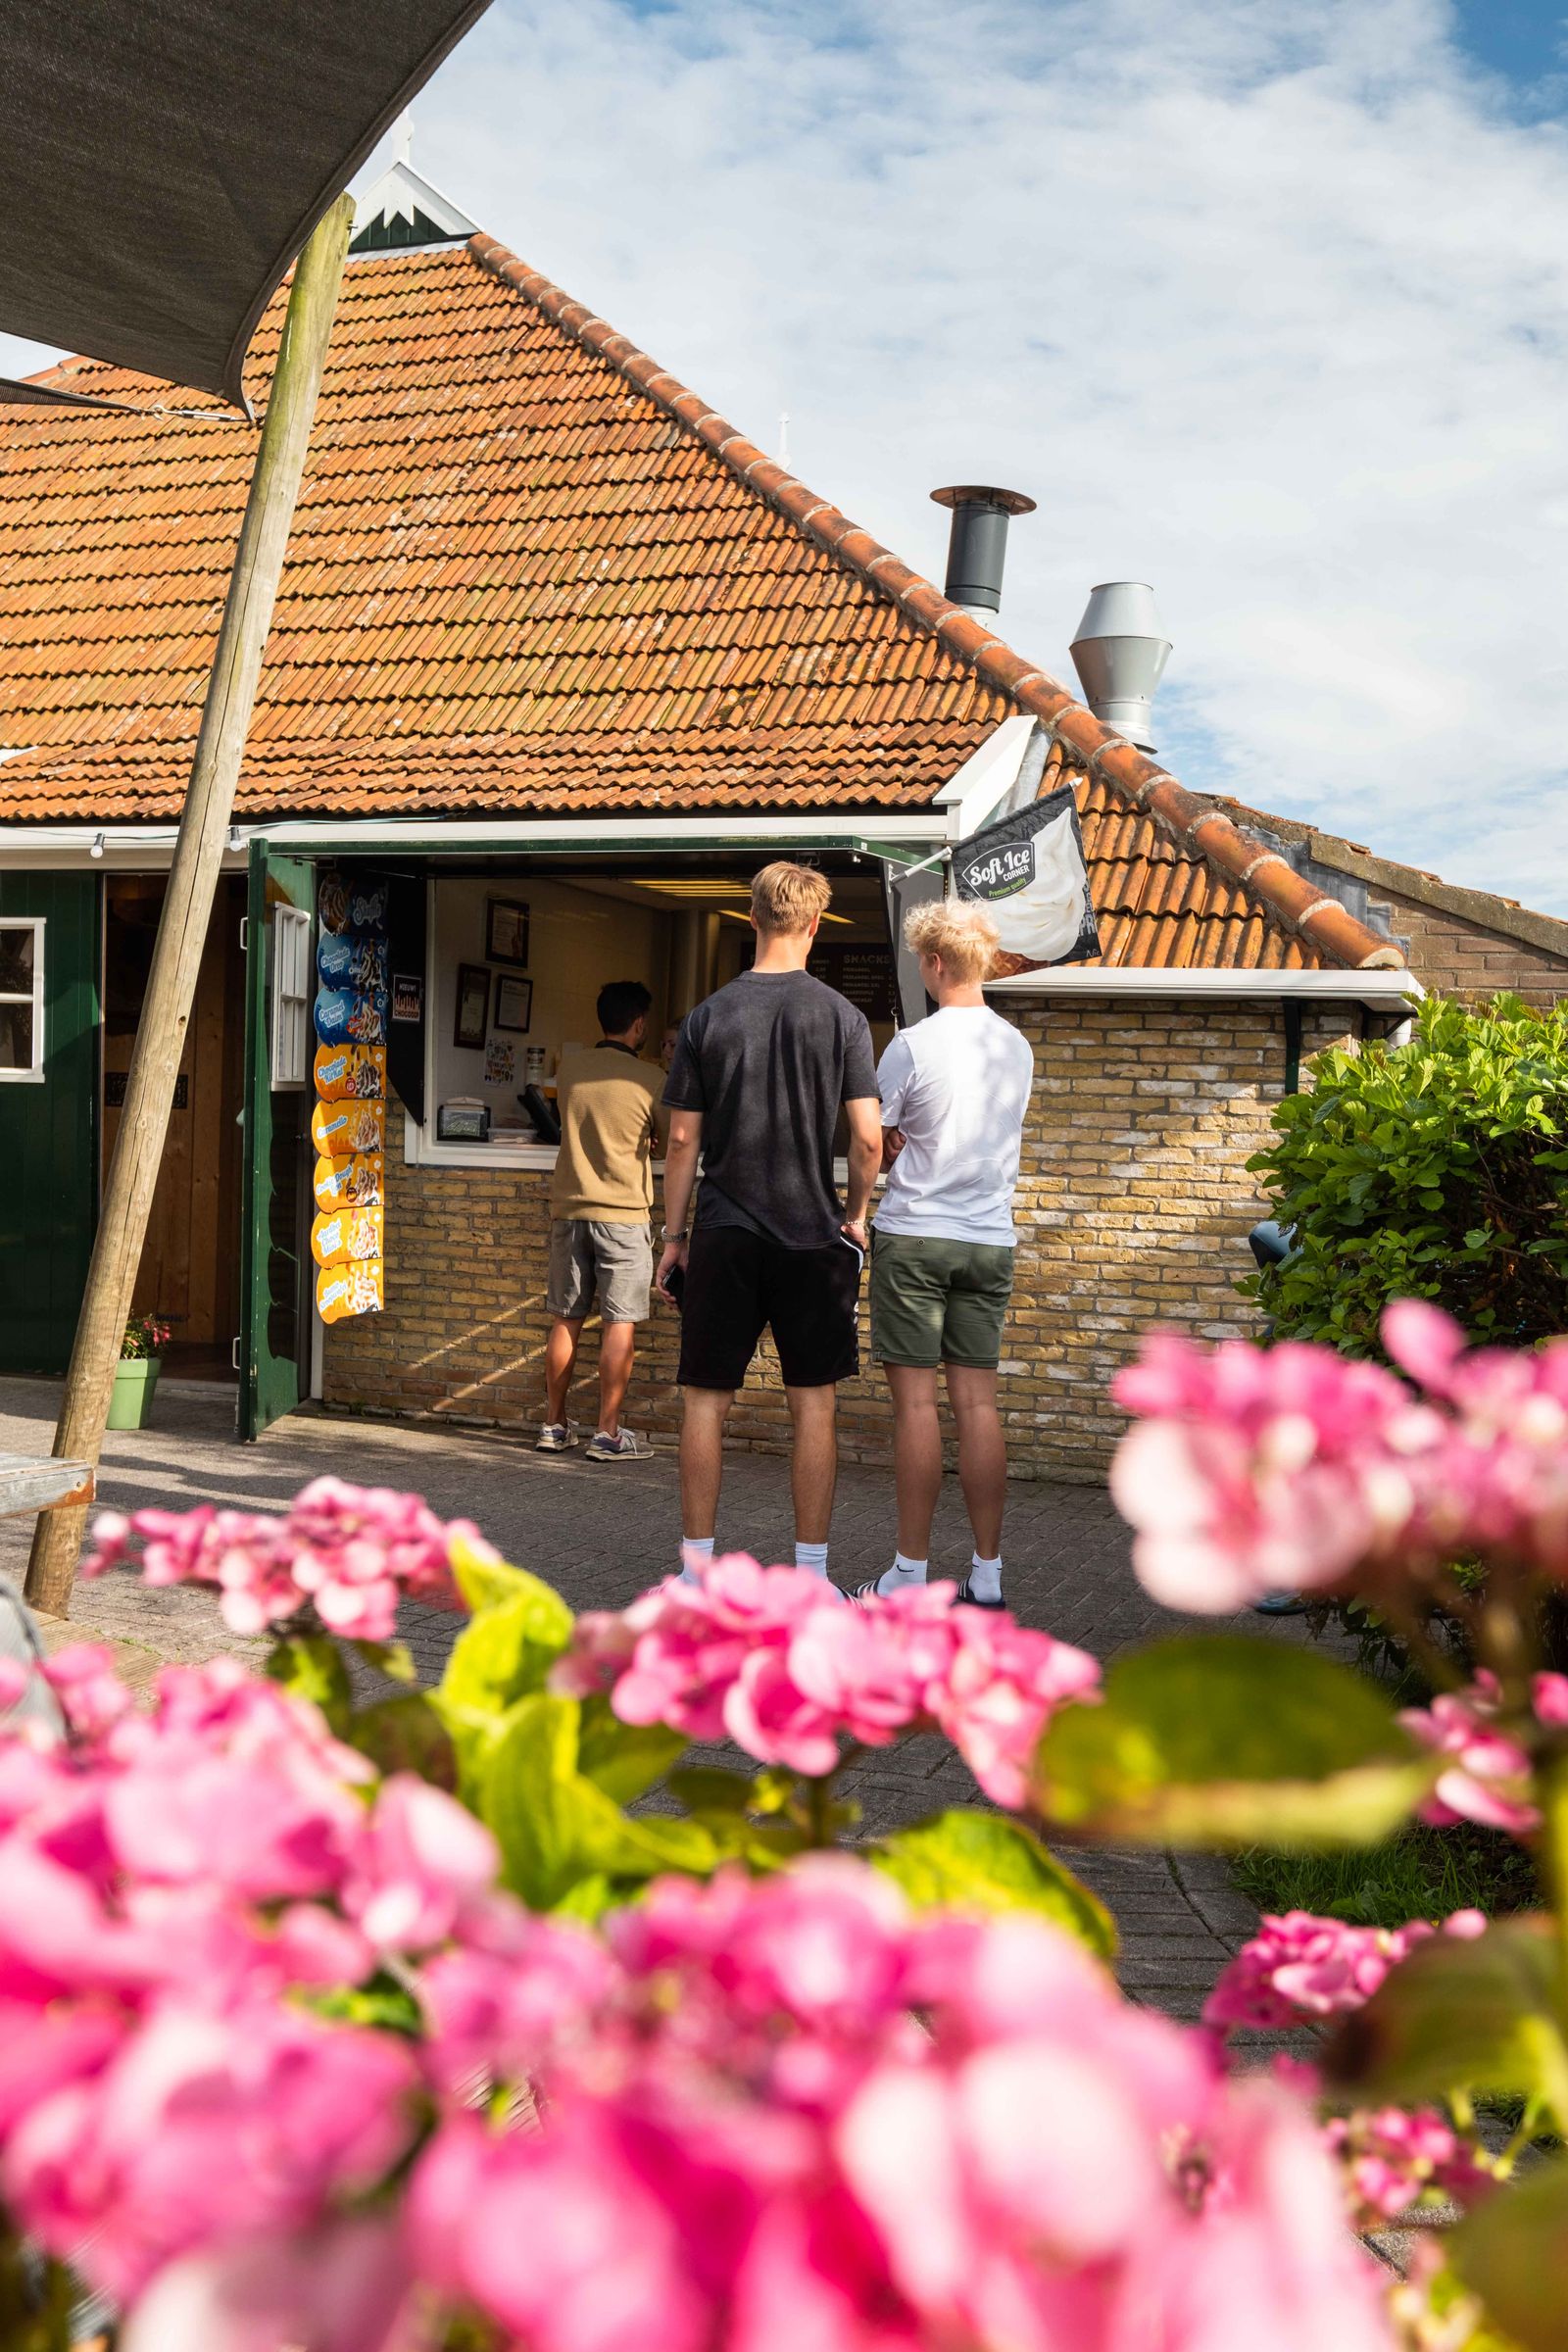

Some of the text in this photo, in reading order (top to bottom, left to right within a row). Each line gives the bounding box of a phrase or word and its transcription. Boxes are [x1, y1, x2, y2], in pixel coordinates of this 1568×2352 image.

[969, 849, 1031, 887] Soft Ice
[1003, 864, 1031, 882] CORNER
[988, 876, 1027, 898] Premium quality
[319, 1000, 345, 1021] Caramel
[334, 1164, 353, 1183] Dough
